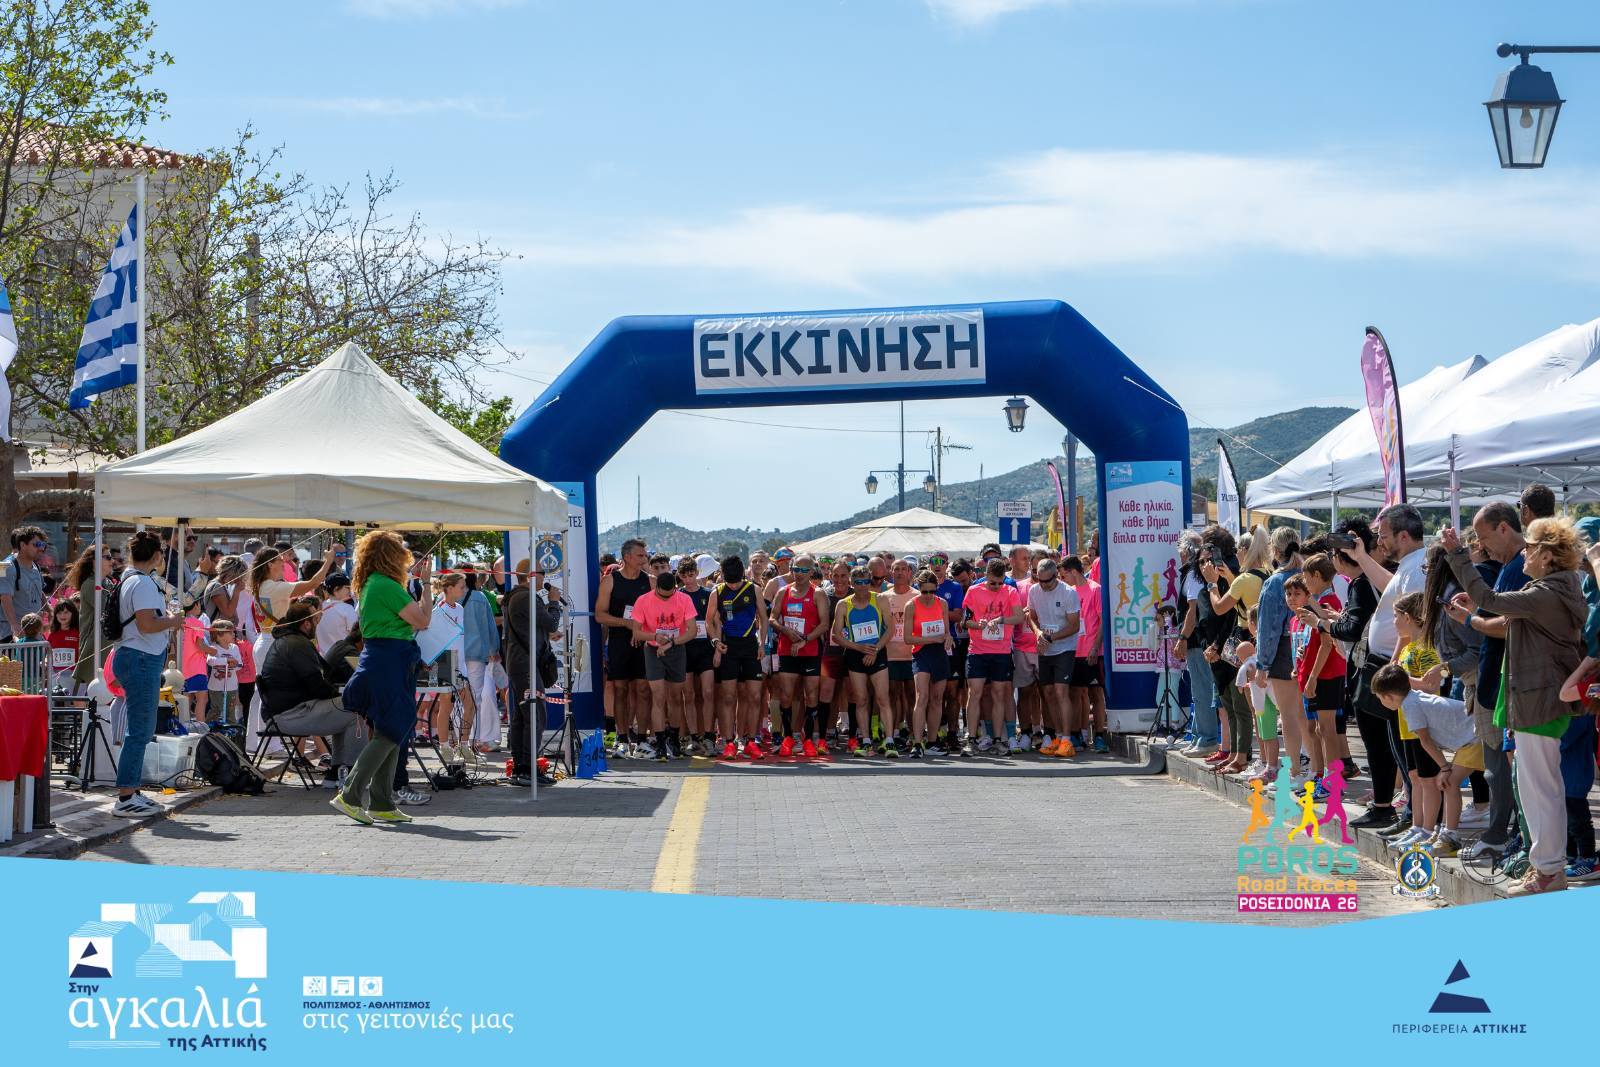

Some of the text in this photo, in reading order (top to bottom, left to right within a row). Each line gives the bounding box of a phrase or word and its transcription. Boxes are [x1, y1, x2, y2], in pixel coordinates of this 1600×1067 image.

[700, 323, 978, 378] ΕΚΚΙΝΗΣΗ
[1119, 500, 1141, 513] Κάθε
[1122, 515, 1169, 530] κάθε βήμα
[1113, 532, 1137, 544] δίπλα
[1139, 534, 1155, 543] στο
